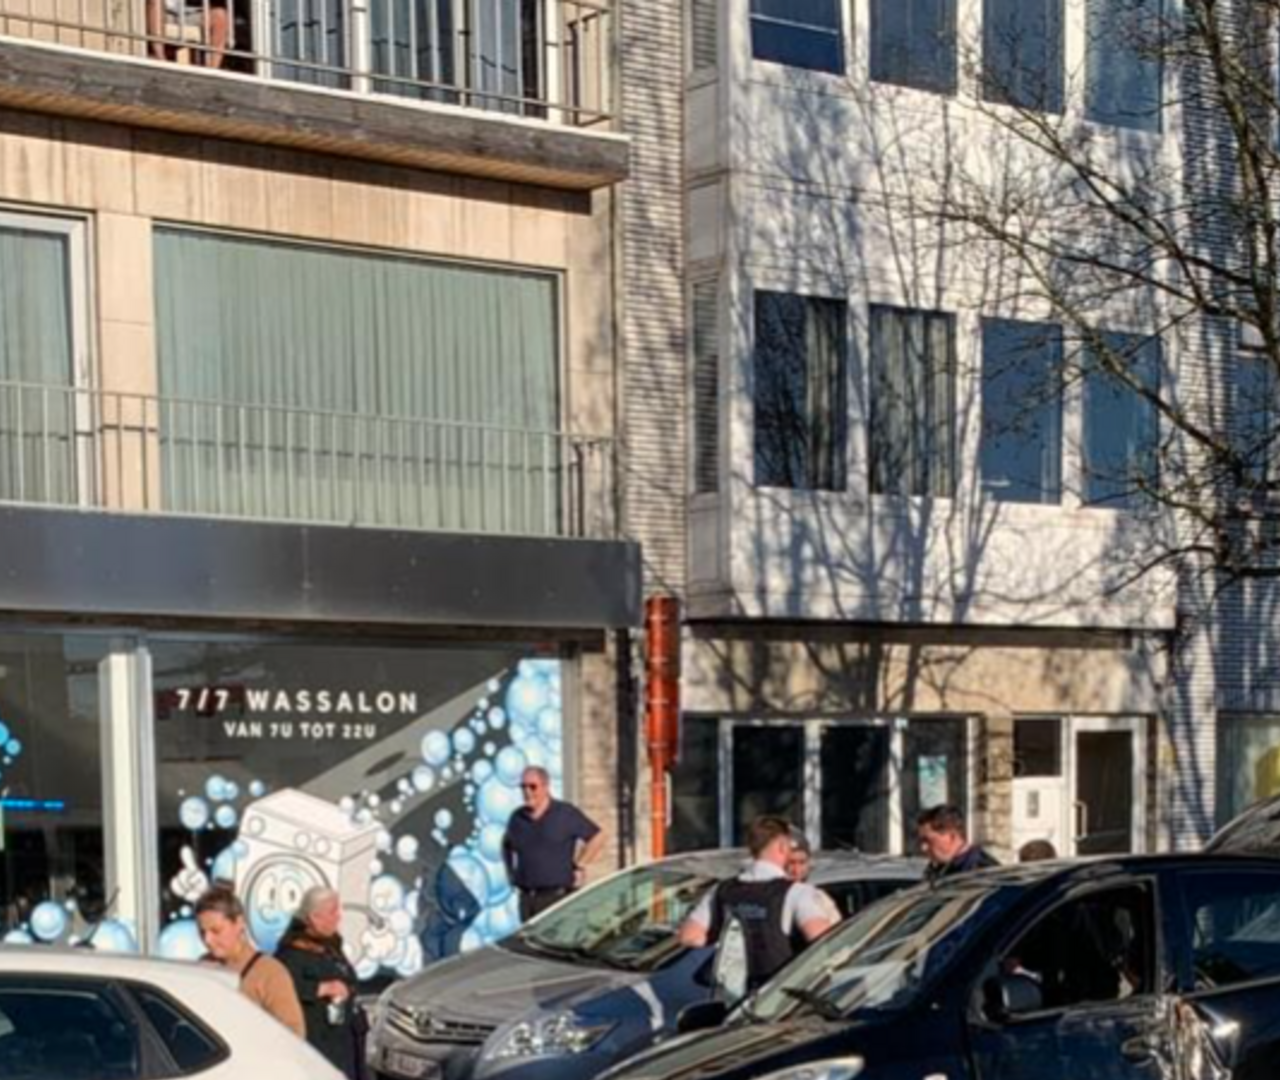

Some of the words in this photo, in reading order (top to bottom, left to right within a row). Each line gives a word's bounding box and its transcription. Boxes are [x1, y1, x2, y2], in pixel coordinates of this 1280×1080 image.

[176, 688, 229, 711] 7/7
[245, 689, 418, 713] WASSALON
[223, 721, 262, 738] VAN
[270, 723, 293, 738] 7U
[299, 722, 335, 739] TOT
[341, 723, 376, 739] 22U
